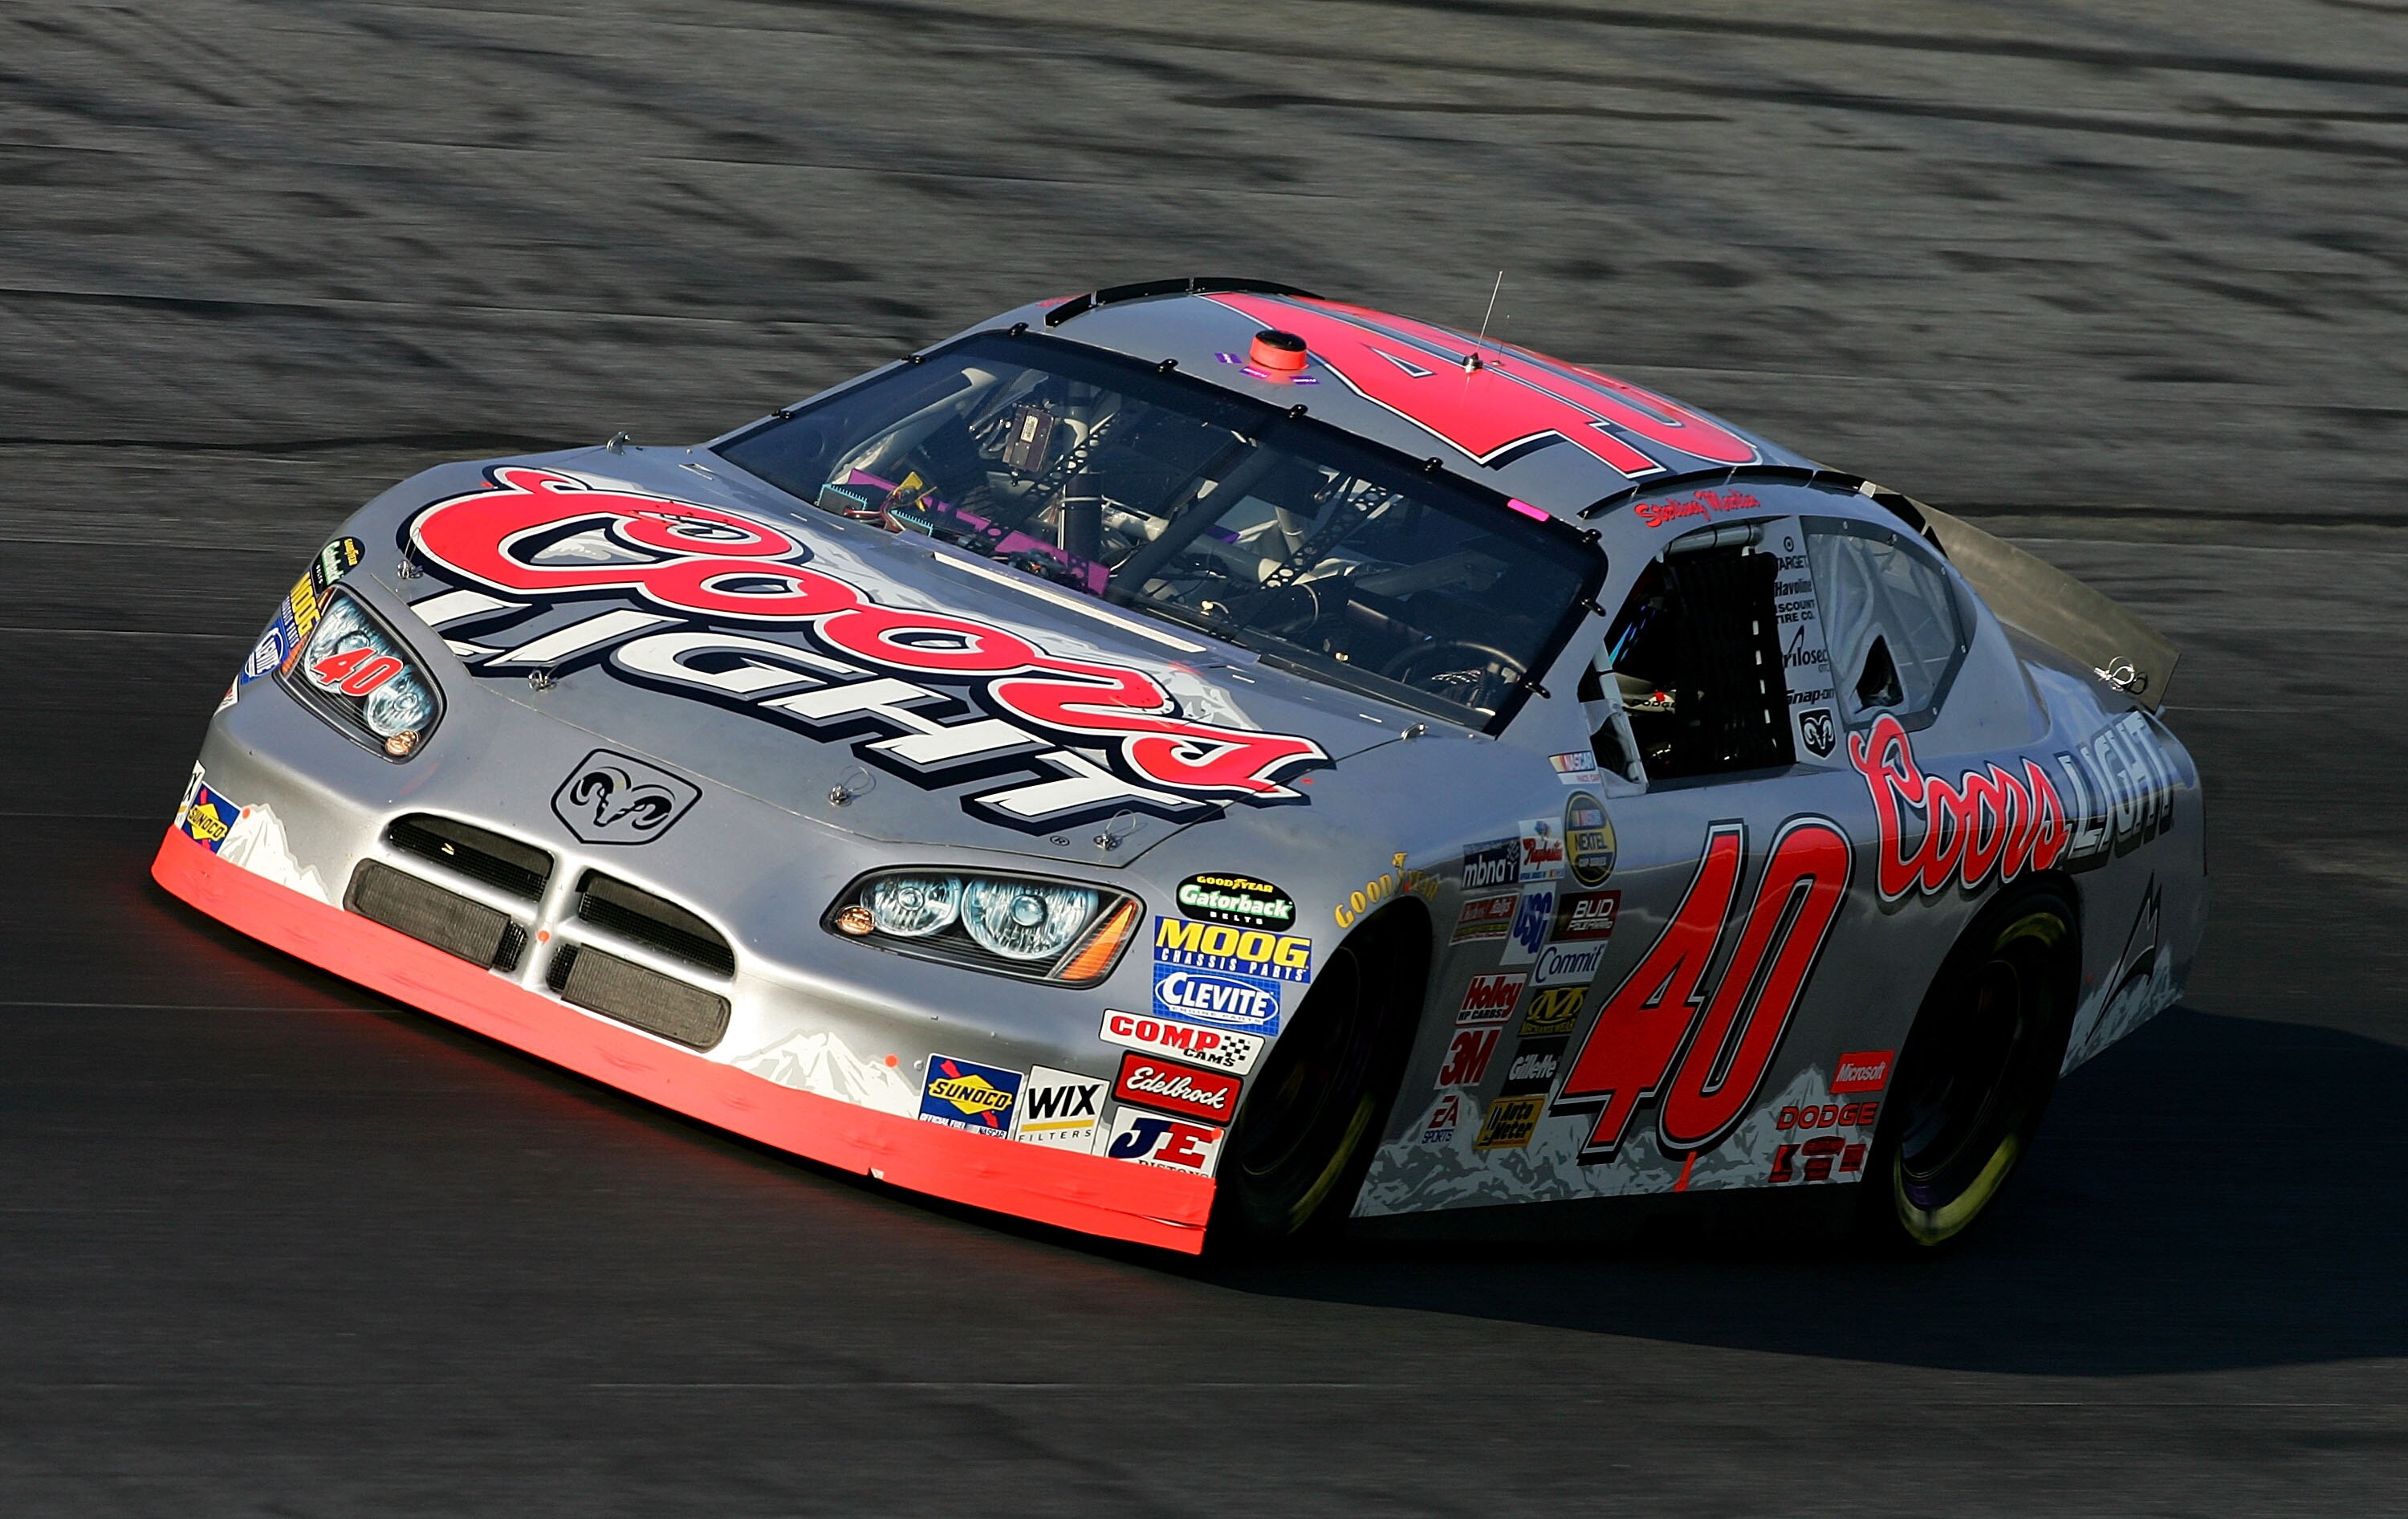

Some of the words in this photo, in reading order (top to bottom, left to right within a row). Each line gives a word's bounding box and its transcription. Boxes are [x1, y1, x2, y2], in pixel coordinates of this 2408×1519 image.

[1776, 555, 1810, 571] ARGET
[1776, 600, 1815, 613] SCOUNT
[408, 466, 1329, 800] Coors
[314, 647, 404, 697] 40
[409, 588, 1207, 817] LIGHT
[2057, 710, 2174, 860] LIGHT
[188, 808, 226, 839] SUNOCO
[1848, 713, 2070, 902] Coors
[1574, 832, 1609, 852] NEXTEL
[1196, 874, 1274, 894] GOODYEAR
[1462, 854, 1507, 887] mbna
[1178, 883, 1293, 921] Gatorback
[1210, 911, 1263, 925] BELTS
[1572, 898, 1614, 918] BUD
[1155, 918, 1311, 970] MOOG
[1161, 948, 1238, 971] CHASSIS
[1249, 962, 1304, 982] PARTS
[1535, 945, 1605, 983] Commit
[1163, 971, 1272, 1017] CLEVITE
[1462, 976, 1523, 1018] Holley
[1552, 815, 1853, 1163] 40
[1109, 1015, 1221, 1053] COMP
[1222, 1013, 1262, 1024] PARTS
[1183, 1048, 1236, 1068] CAMS
[1440, 1029, 1500, 1086] 3M
[1508, 1053, 1558, 1081] Gillette
[1836, 1060, 1886, 1082] Microsoft
[932, 1080, 1011, 1109] SUNOCO
[1028, 1084, 1101, 1120] WIX
[1125, 1065, 1226, 1110] Edelbrock
[1428, 1095, 1459, 1129] EA
[1500, 1102, 1534, 1122] Auto
[1775, 1100, 1880, 1130] DODGE
[1019, 1128, 1092, 1142] FILTERS
[1108, 1117, 1214, 1170] JE
[1422, 1128, 1455, 1144] SPORTS
[1493, 1118, 1533, 1140] Meter
